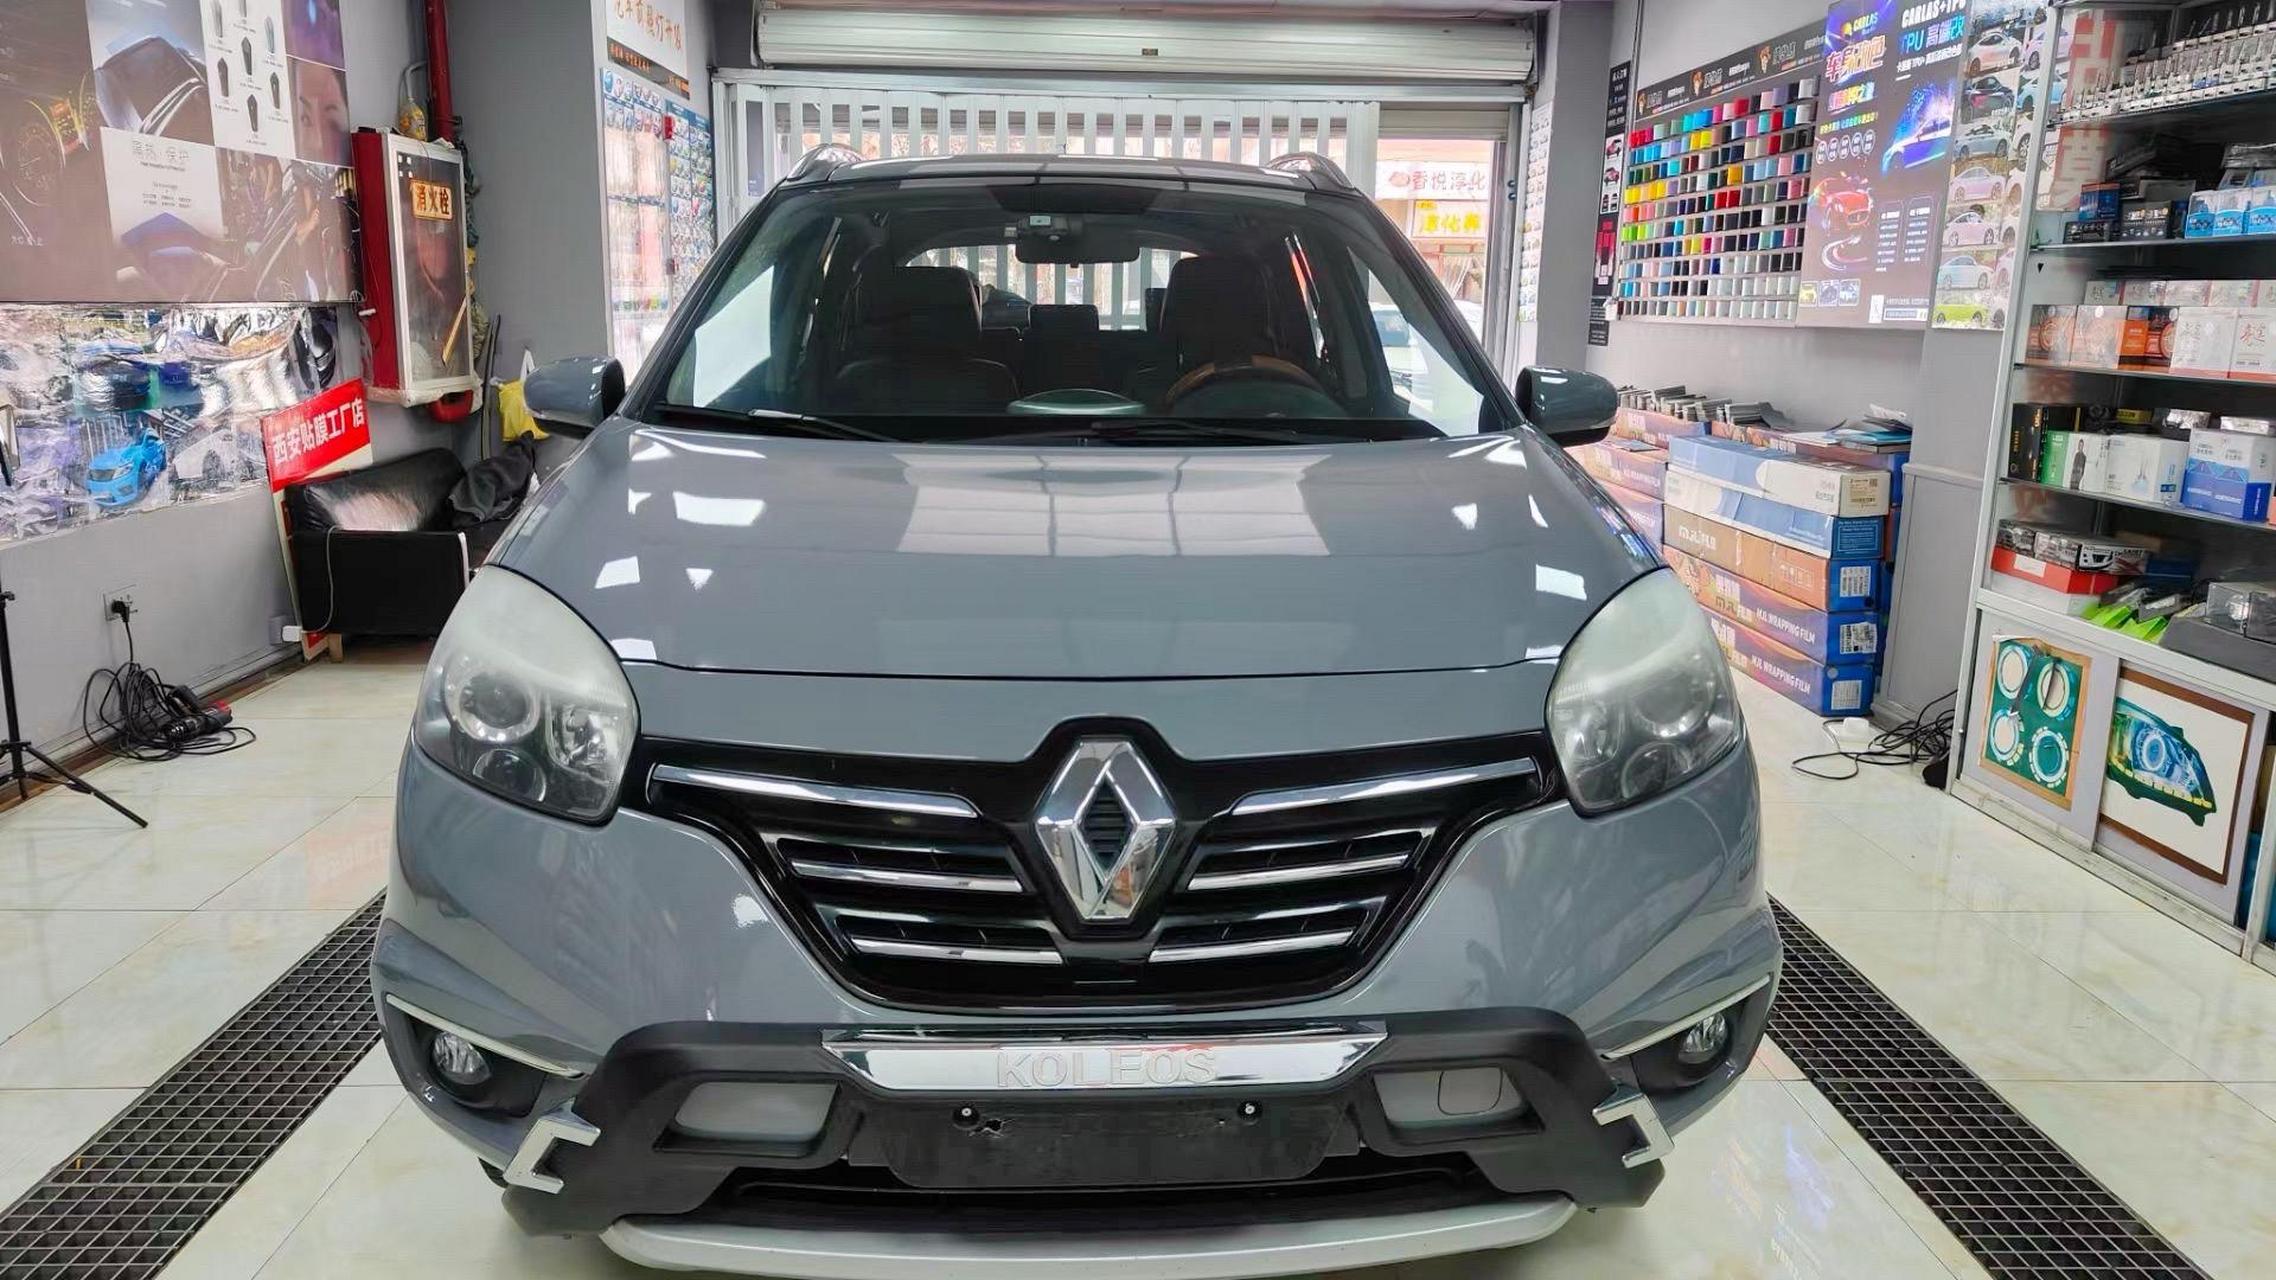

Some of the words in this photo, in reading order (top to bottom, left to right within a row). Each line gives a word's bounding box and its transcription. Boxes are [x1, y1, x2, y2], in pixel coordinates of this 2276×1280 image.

[416, 184, 450, 215] 消火栓
[272, 396, 365, 467] 西安贴膜工厂店
[1768, 612, 1800, 638] WRAPPING
[1799, 627, 1816, 645] FILM
[1763, 659, 1796, 686] WRAPPING
[1795, 674, 1812, 696] FILM
[997, 1049, 1218, 1088] KOLEOS
